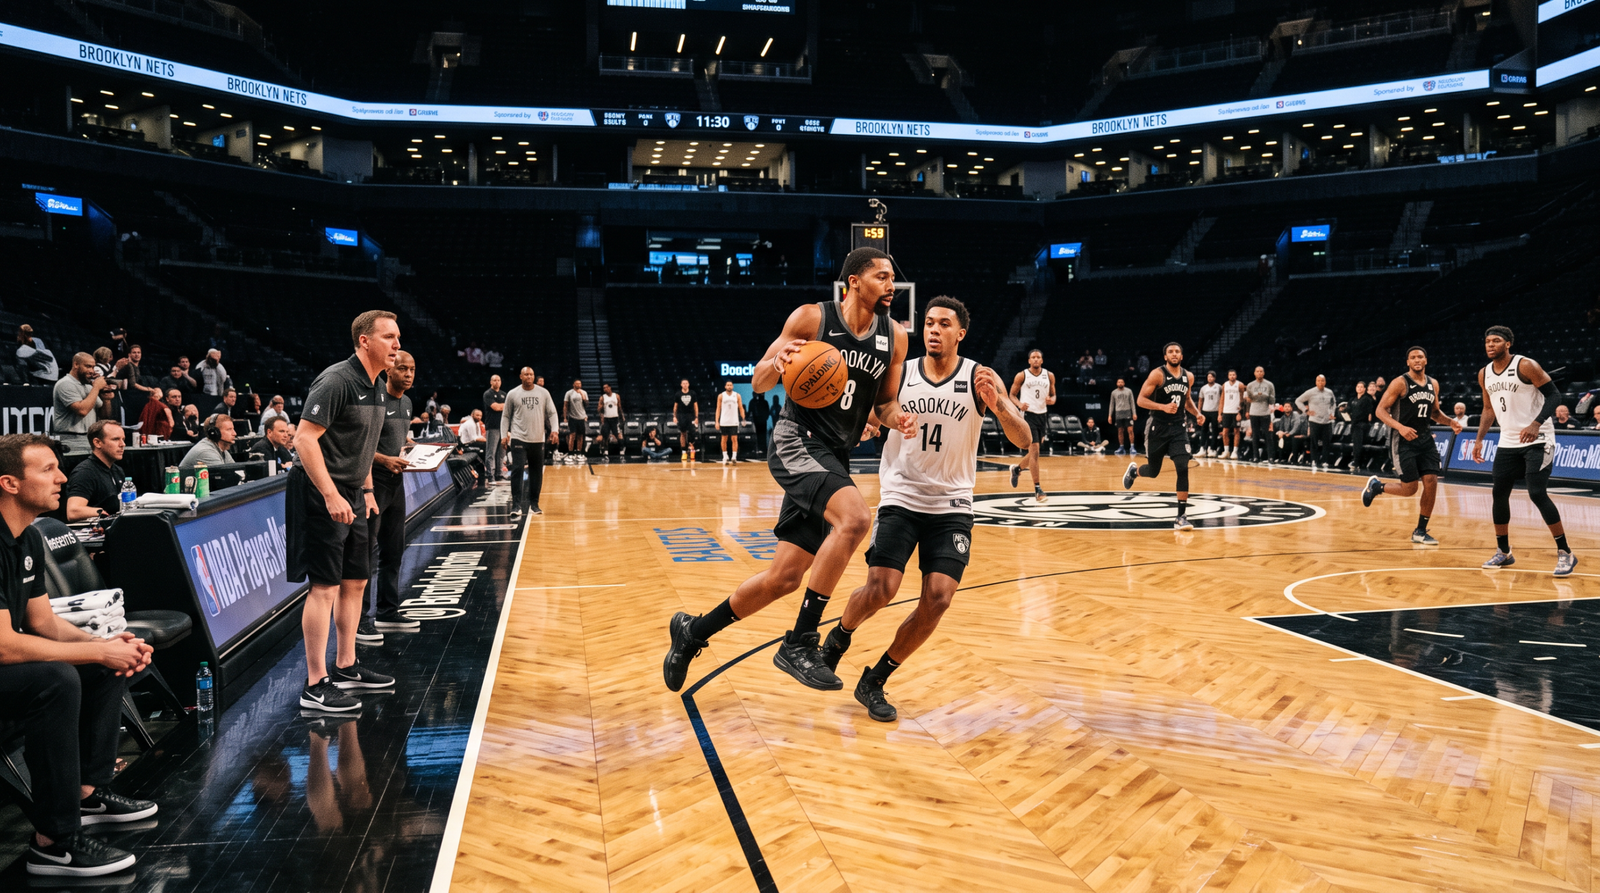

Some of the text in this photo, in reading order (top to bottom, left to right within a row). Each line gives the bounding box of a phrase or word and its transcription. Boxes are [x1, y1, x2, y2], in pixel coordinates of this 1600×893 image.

[79, 44, 175, 77] BROOKLYN NETS
[227, 77, 307, 106] BROOKLYN NETS
[696, 115, 730, 128] 11:30
[855, 121, 930, 136] BROOKLYN NETS
[1092, 113, 1168, 135] BROOKLYN NETS
[864, 228, 884, 239] 1:59
[799, 355, 838, 395] SPALDING
[840, 349, 887, 380] OOKLYN
[840, 379, 856, 410] 8
[1035, 389, 1040, 399] 3
[1499, 396, 1507, 413] 3
[901, 397, 969, 422] BROOKLYN
[920, 422, 942, 452] 14
[203, 536, 246, 609] NBA
